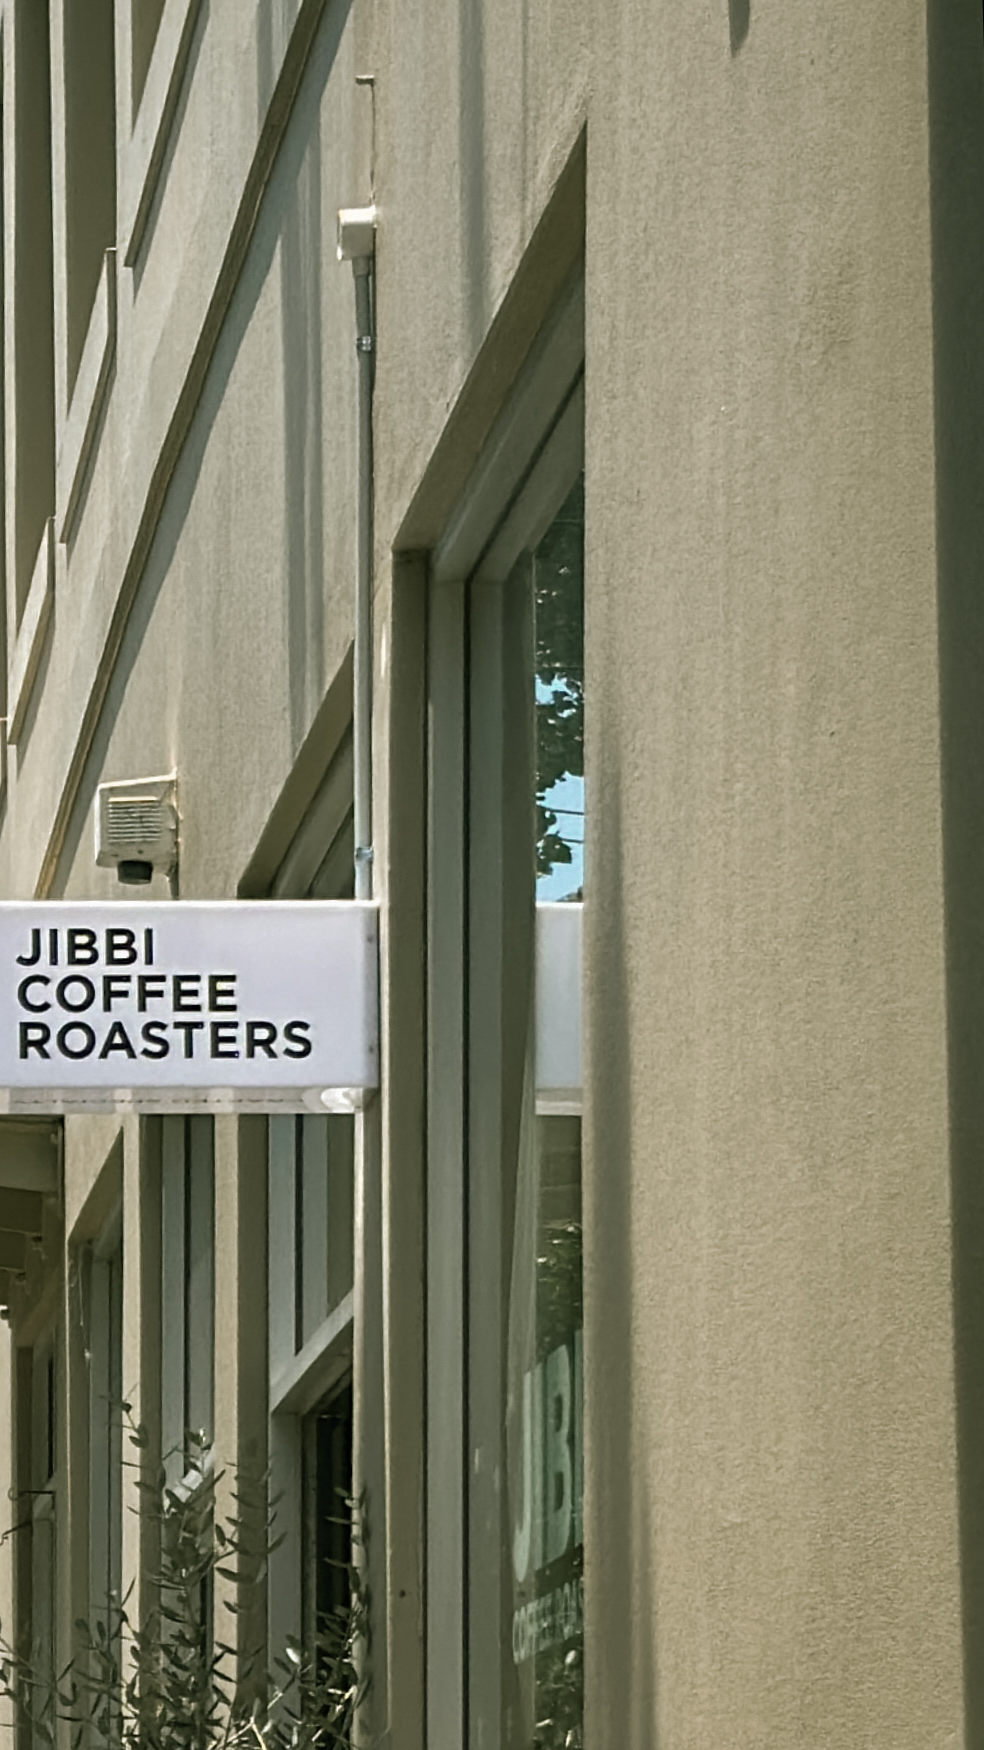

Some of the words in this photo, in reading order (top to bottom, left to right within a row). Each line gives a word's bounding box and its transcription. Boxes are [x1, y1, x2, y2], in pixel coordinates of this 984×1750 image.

[16, 928, 154, 966] JIBBI
[17, 974, 238, 1013] COFFEE
[19, 1020, 313, 1060] ROASTERS
